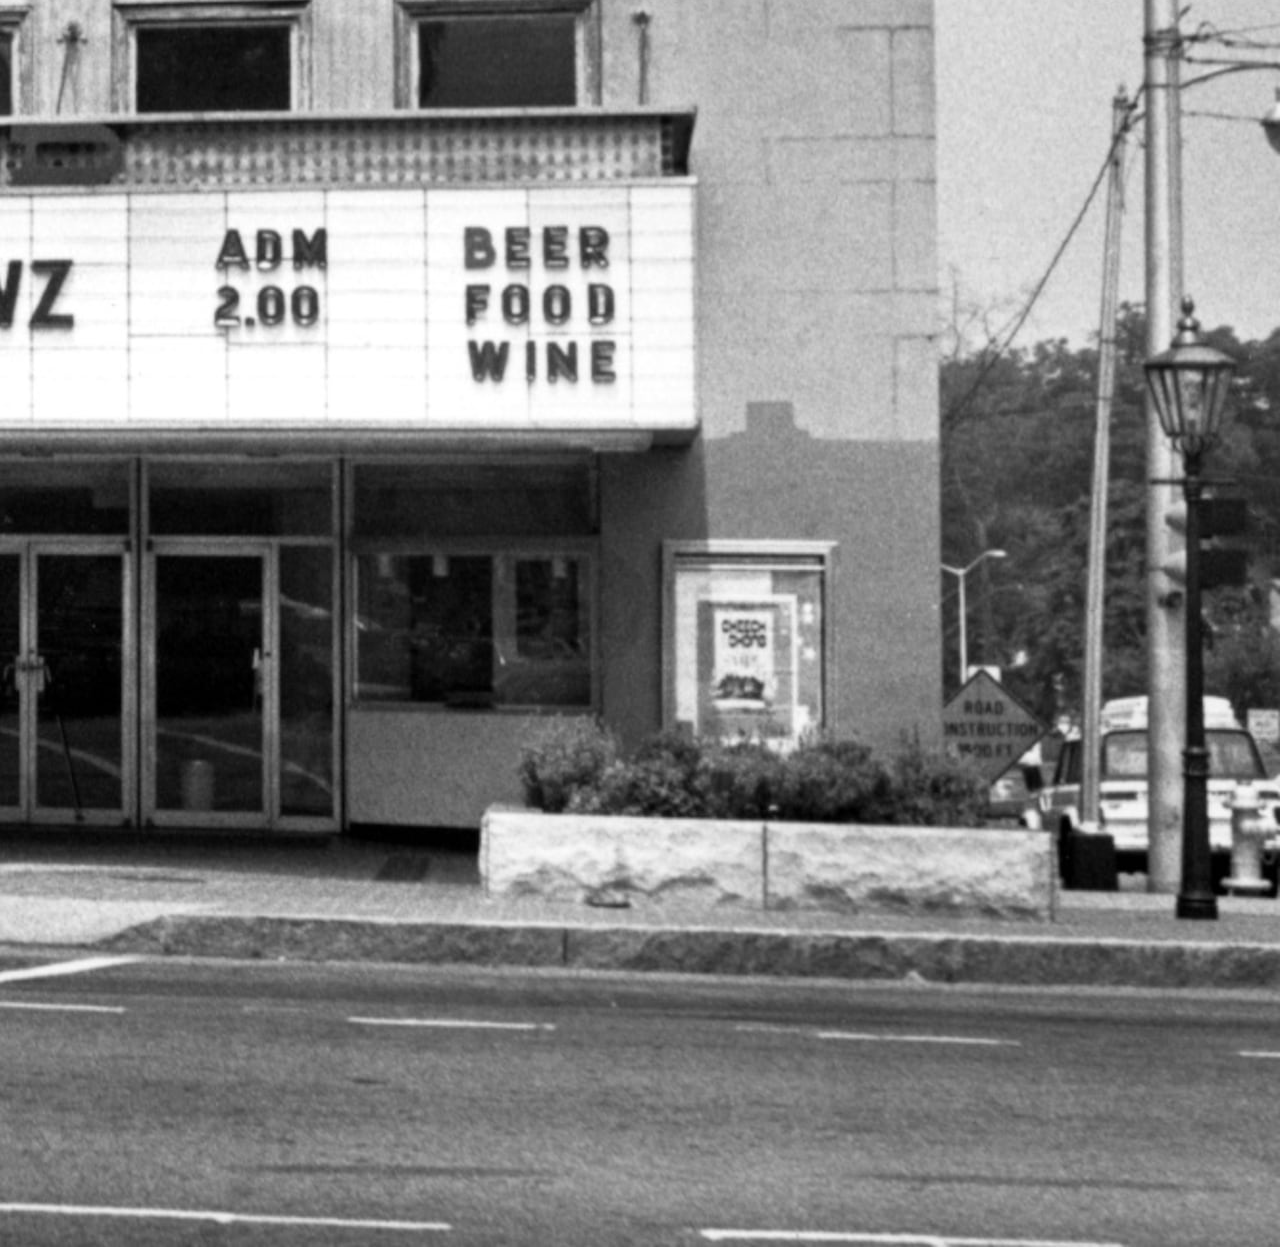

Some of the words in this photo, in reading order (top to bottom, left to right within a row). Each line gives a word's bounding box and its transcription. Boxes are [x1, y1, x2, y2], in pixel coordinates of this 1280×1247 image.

[215, 226, 328, 271] ADM
[462, 225, 611, 270] BEER
[212, 283, 322, 328] 2.00
[463, 282, 617, 328] FOOD
[467, 338, 619, 383] WINE
[963, 699, 1004, 715] ROAD
